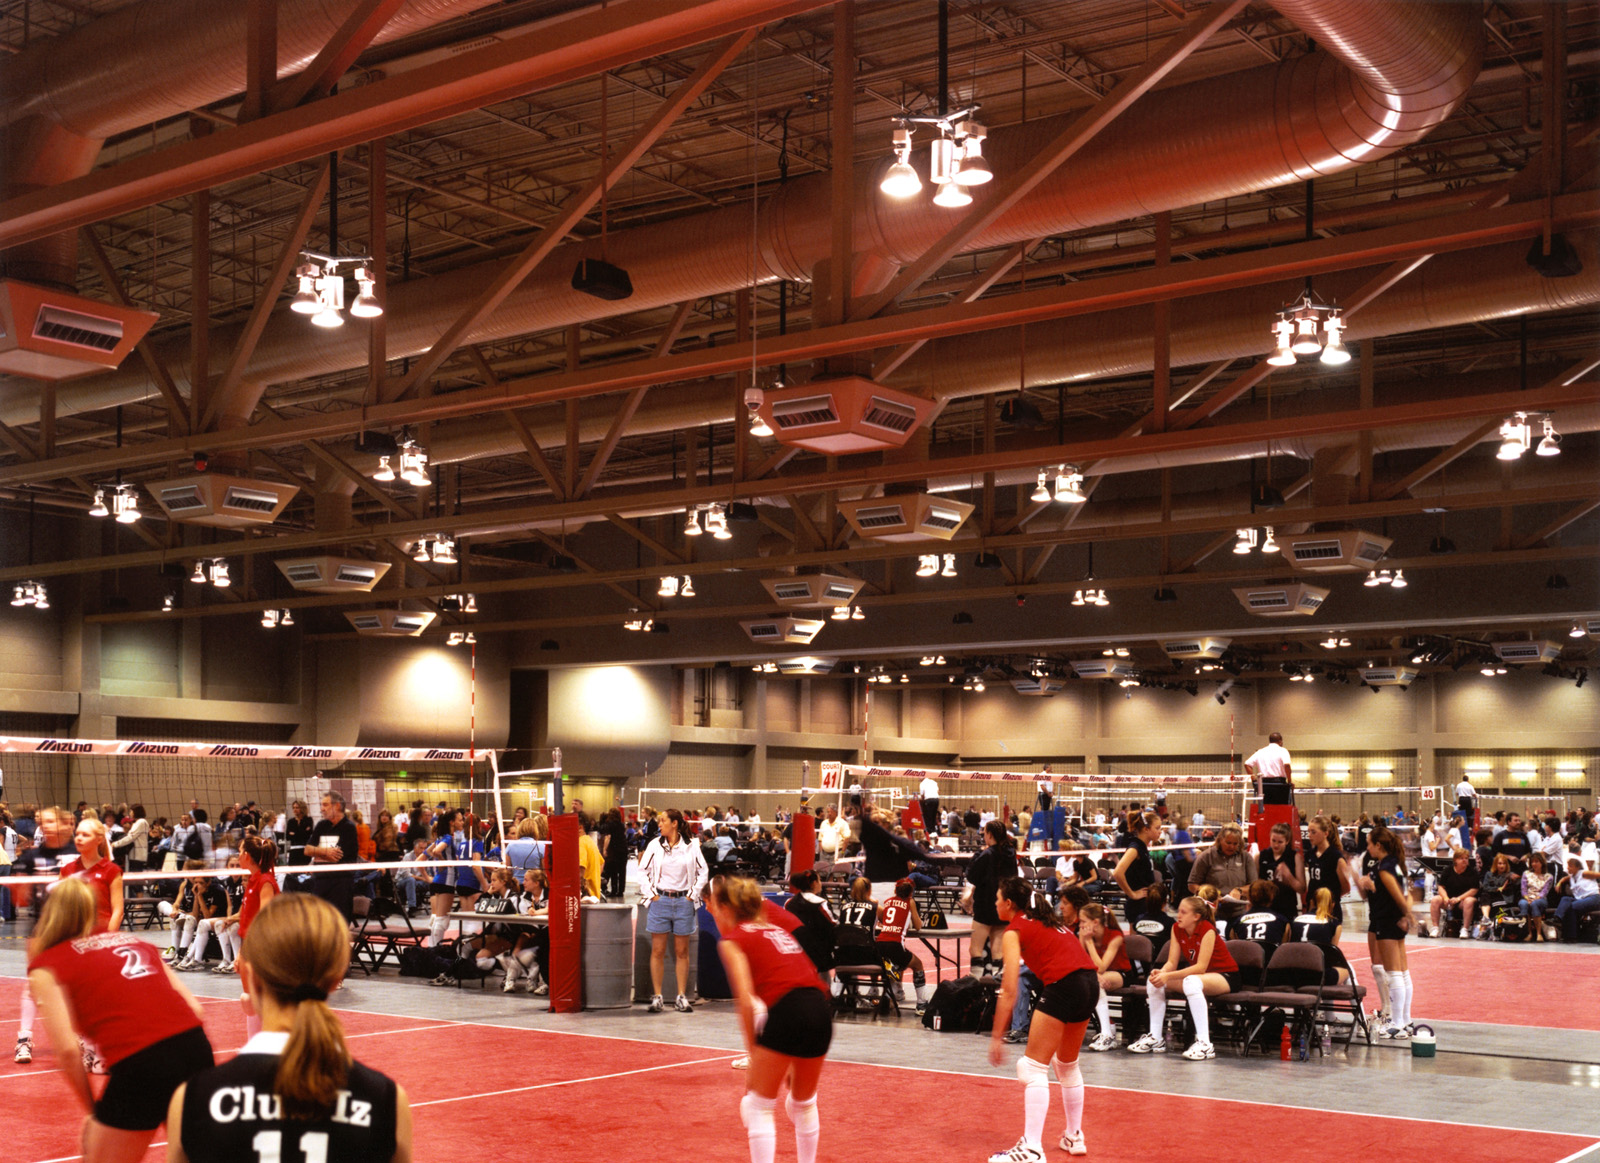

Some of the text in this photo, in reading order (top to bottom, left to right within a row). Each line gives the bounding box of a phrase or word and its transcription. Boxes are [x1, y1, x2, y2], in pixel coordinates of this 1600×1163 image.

[823, 771, 837, 788] 41
[1423, 789, 1433, 799] 40
[460, 844, 466, 859] 7
[1310, 867, 1321, 881] 19
[479, 900, 487, 912] 8
[497, 901, 507, 912] 11
[892, 899, 908, 911] TEXAS
[844, 907, 865, 926] 17
[885, 907, 897, 924] 9
[930, 913, 940, 927] 0
[1246, 923, 1267, 940] 12
[1301, 923, 1310, 941] 1
[112, 945, 152, 980] 2
[1188, 949, 1196, 960] 7
[208, 1085, 284, 1124] Clu
[252, 1130, 330, 1163] 11
